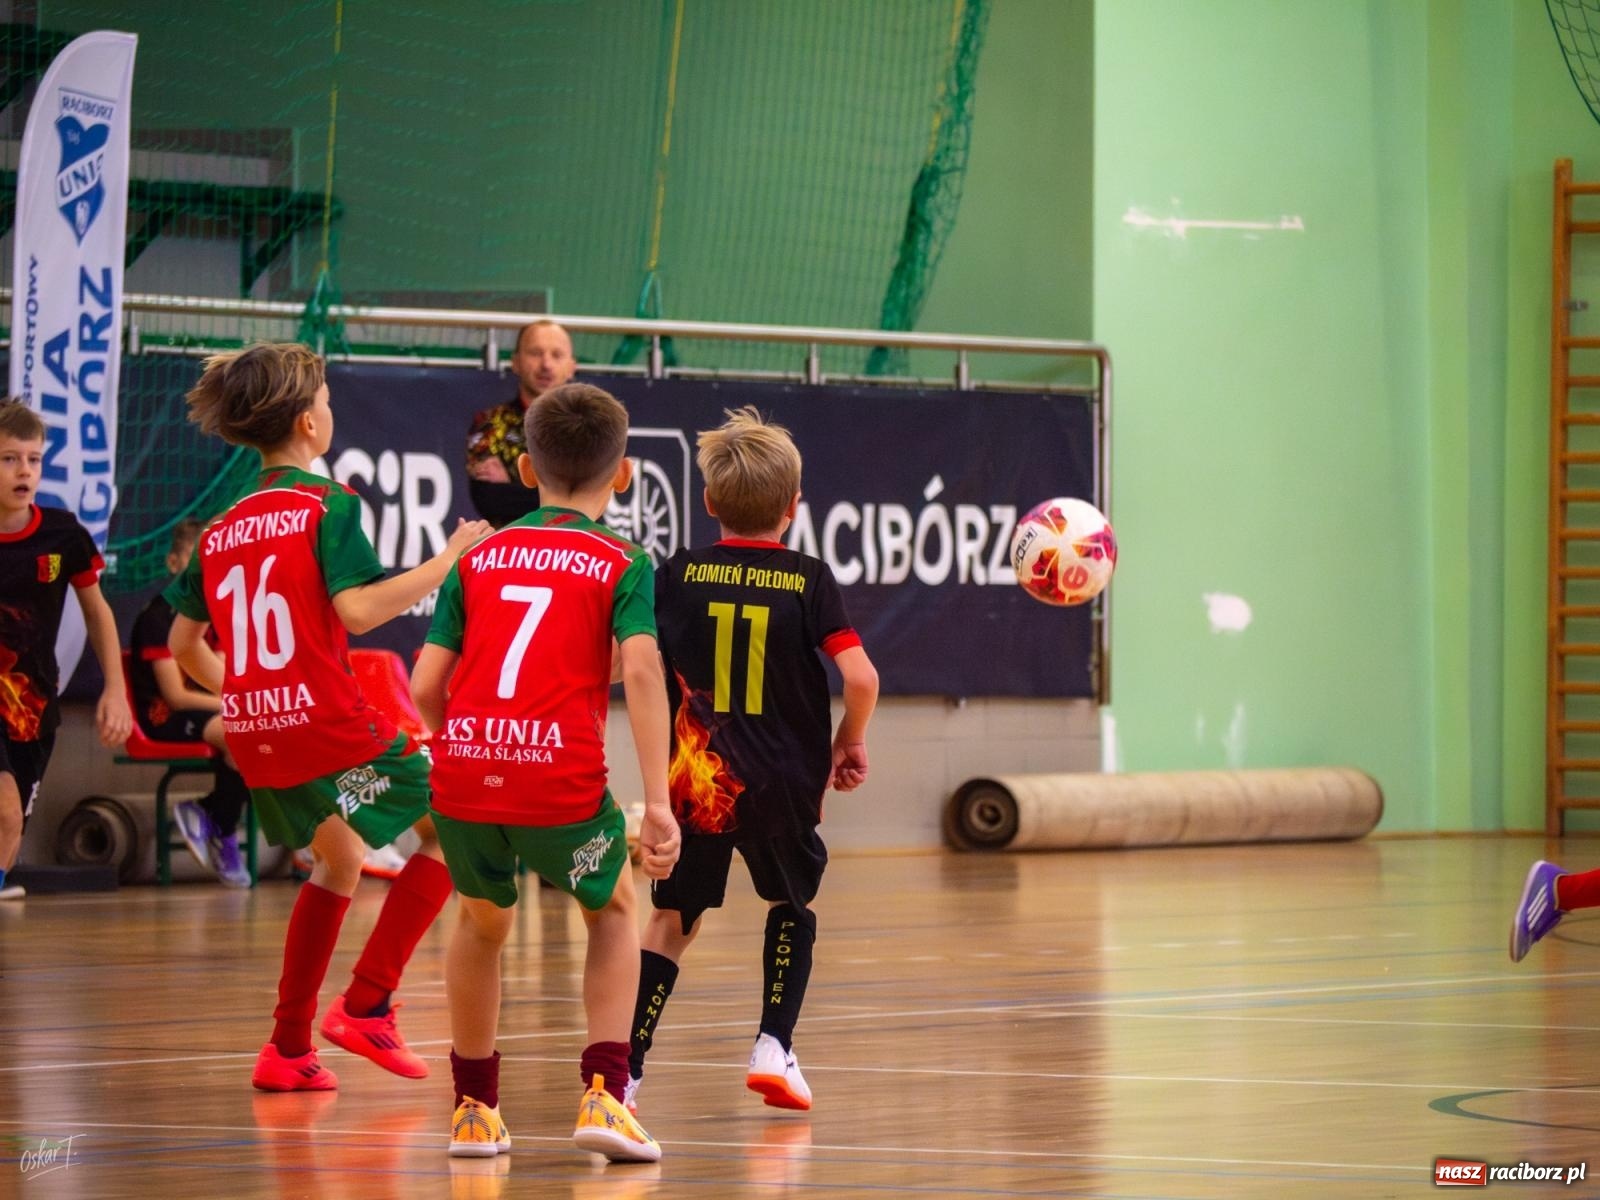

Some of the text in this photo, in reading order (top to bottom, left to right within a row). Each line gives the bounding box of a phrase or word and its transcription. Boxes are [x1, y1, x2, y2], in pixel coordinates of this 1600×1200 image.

[204, 508, 311, 556] STARZYNSKI
[788, 473, 1018, 586] ACIBÓRZ
[684, 563, 743, 586] PŁOMIEŃ
[216, 553, 296, 677] 16
[497, 584, 553, 699] 7
[708, 601, 770, 715] 11
[244, 682, 317, 717] UNIA
[256, 711, 311, 732] ŚLĄSKA
[484, 717, 565, 749] UNIA
[494, 743, 553, 765] ŚLĄSKA
[770, 921, 795, 1005] PŁOMIEŃ
